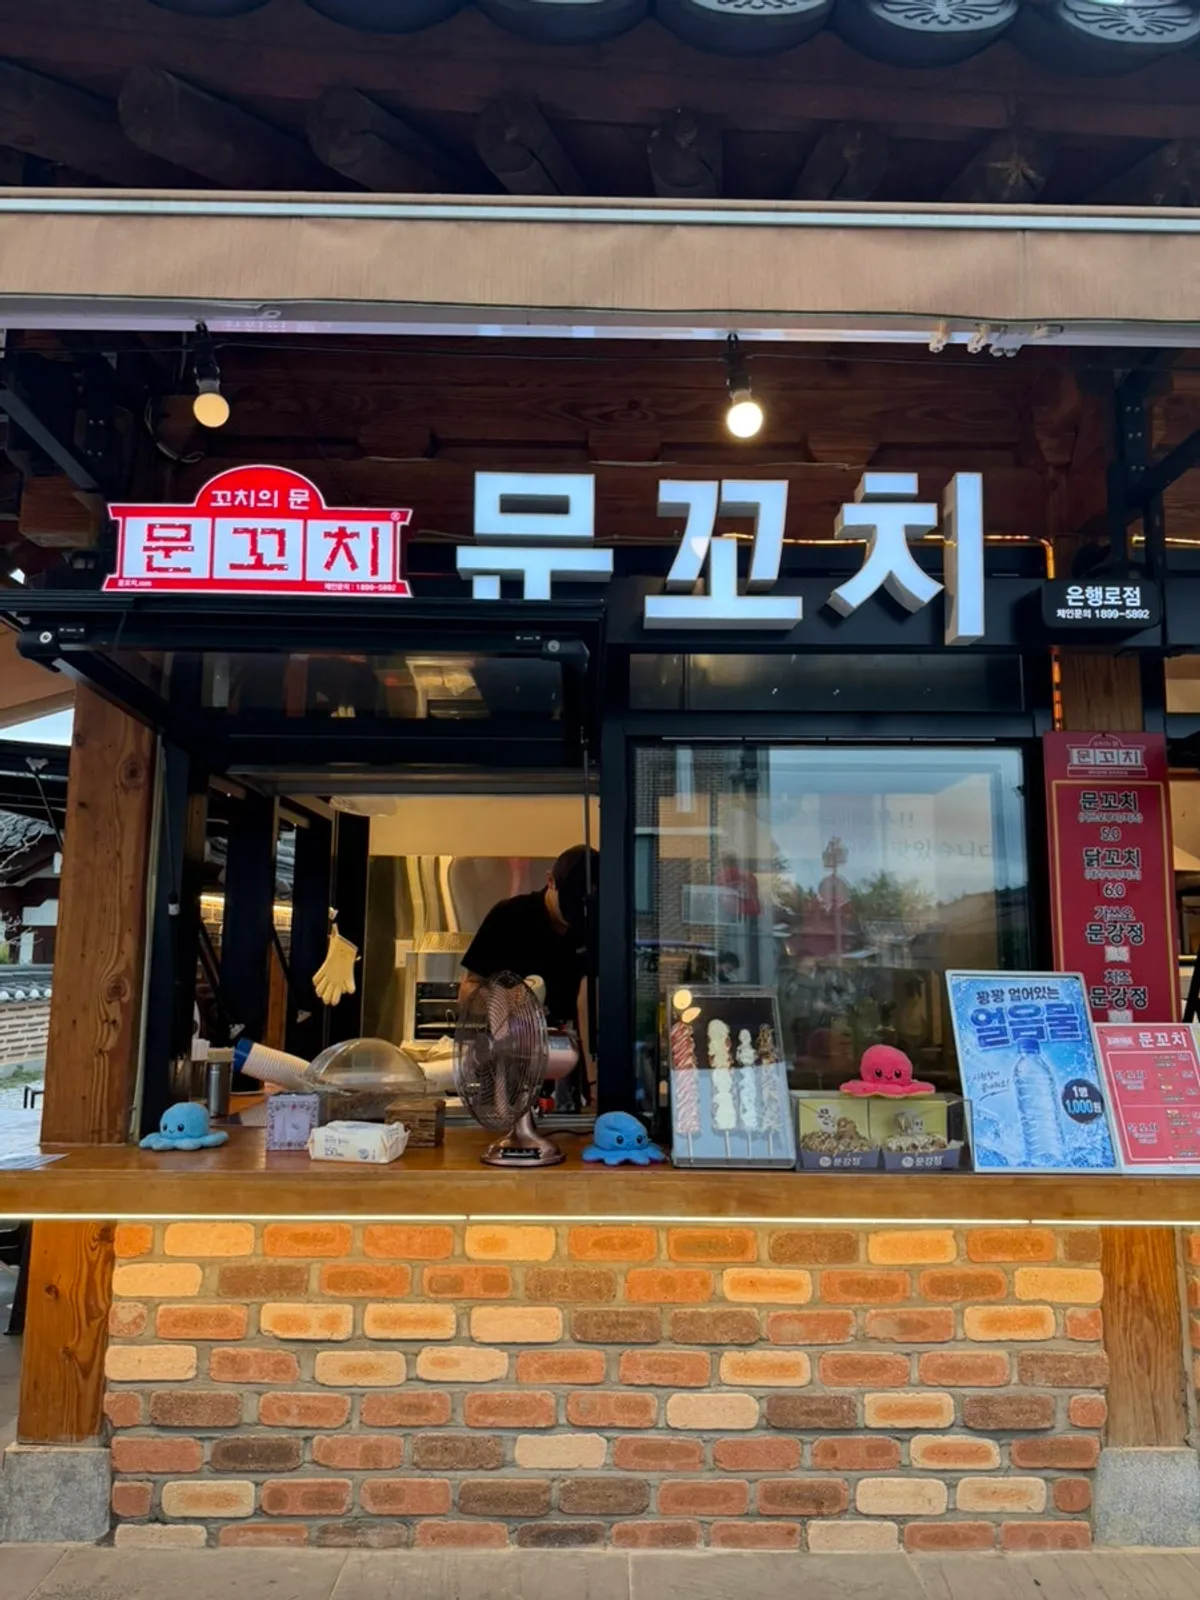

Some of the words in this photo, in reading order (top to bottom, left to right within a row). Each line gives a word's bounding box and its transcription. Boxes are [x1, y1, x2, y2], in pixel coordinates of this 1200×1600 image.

[210, 489, 278, 508] 꼬치의
[288, 488, 310, 510] 문
[142, 522, 380, 577] 문꼬치
[1066, 585, 1141, 606] 은행로점
[1056, 608, 1092, 619] 체인문의
[1095, 609, 1150, 619] 1899-5892
[1075, 750, 1139, 764] 문꼬치
[1081, 792, 1138, 811] 문꼬치
[1084, 848, 1141, 868] 닭꼬치
[1104, 884, 1125, 898] 6.0
[1086, 923, 1144, 945] 문강정
[1104, 970, 1133, 985] 치즈
[1008, 986, 1060, 1002] 얼어있는
[1091, 987, 1148, 1009] 문강정
[970, 1002, 1082, 1049] 얼음물
[1138, 1031, 1188, 1048] 문꼬치
